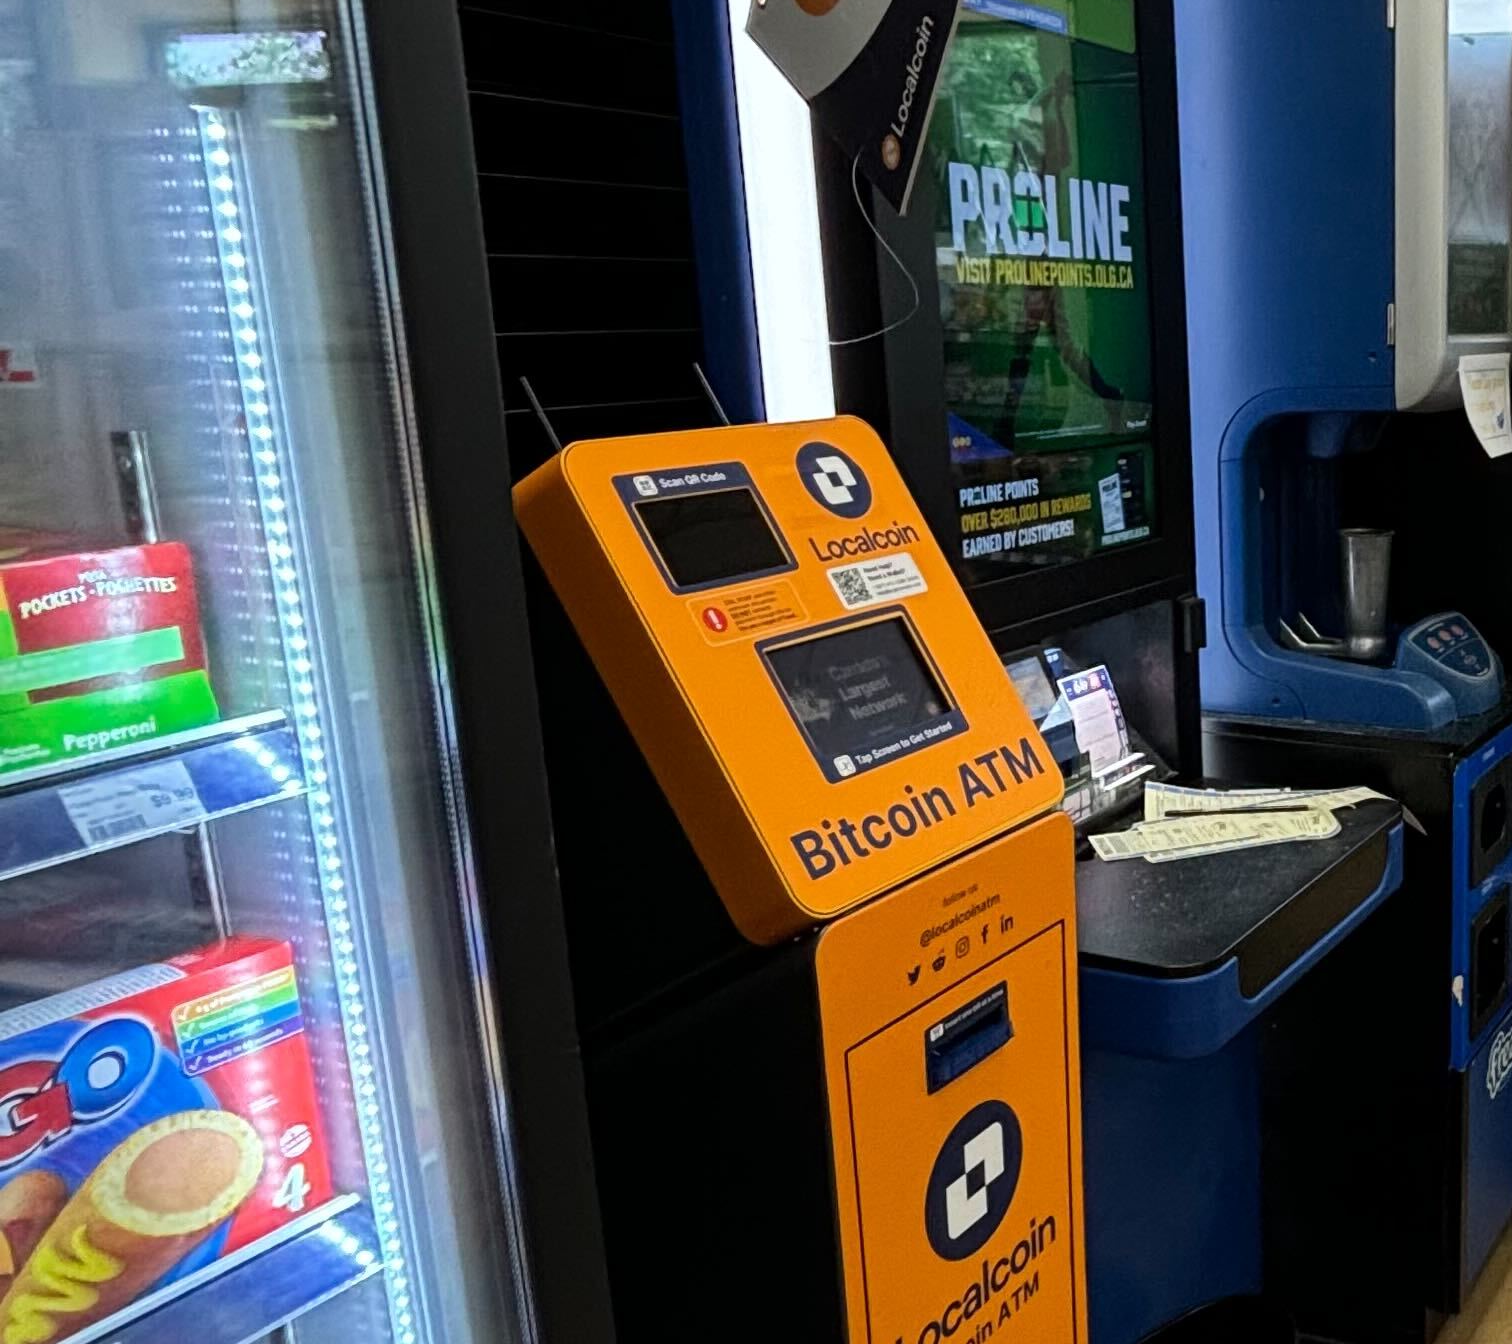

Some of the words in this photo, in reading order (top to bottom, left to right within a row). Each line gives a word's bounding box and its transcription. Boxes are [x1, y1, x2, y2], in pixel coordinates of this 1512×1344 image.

[890, 15, 935, 140] Localcoin
[659, 475, 685, 488] Scan
[700, 470, 726, 484] Code
[808, 520, 921, 562] Localcoin
[961, 513, 988, 534] OVER
[962, 534, 1002, 559] EARNED
[1003, 530, 1016, 550] BY
[18, 586, 88, 620] POCKETS
[62, 714, 157, 752] Pepperoni
[790, 784, 957, 881] Bitcoin
[958, 737, 1045, 808] ATM
[273, 1163, 311, 1213] 4
[996, 1270, 1041, 1329] ATM
